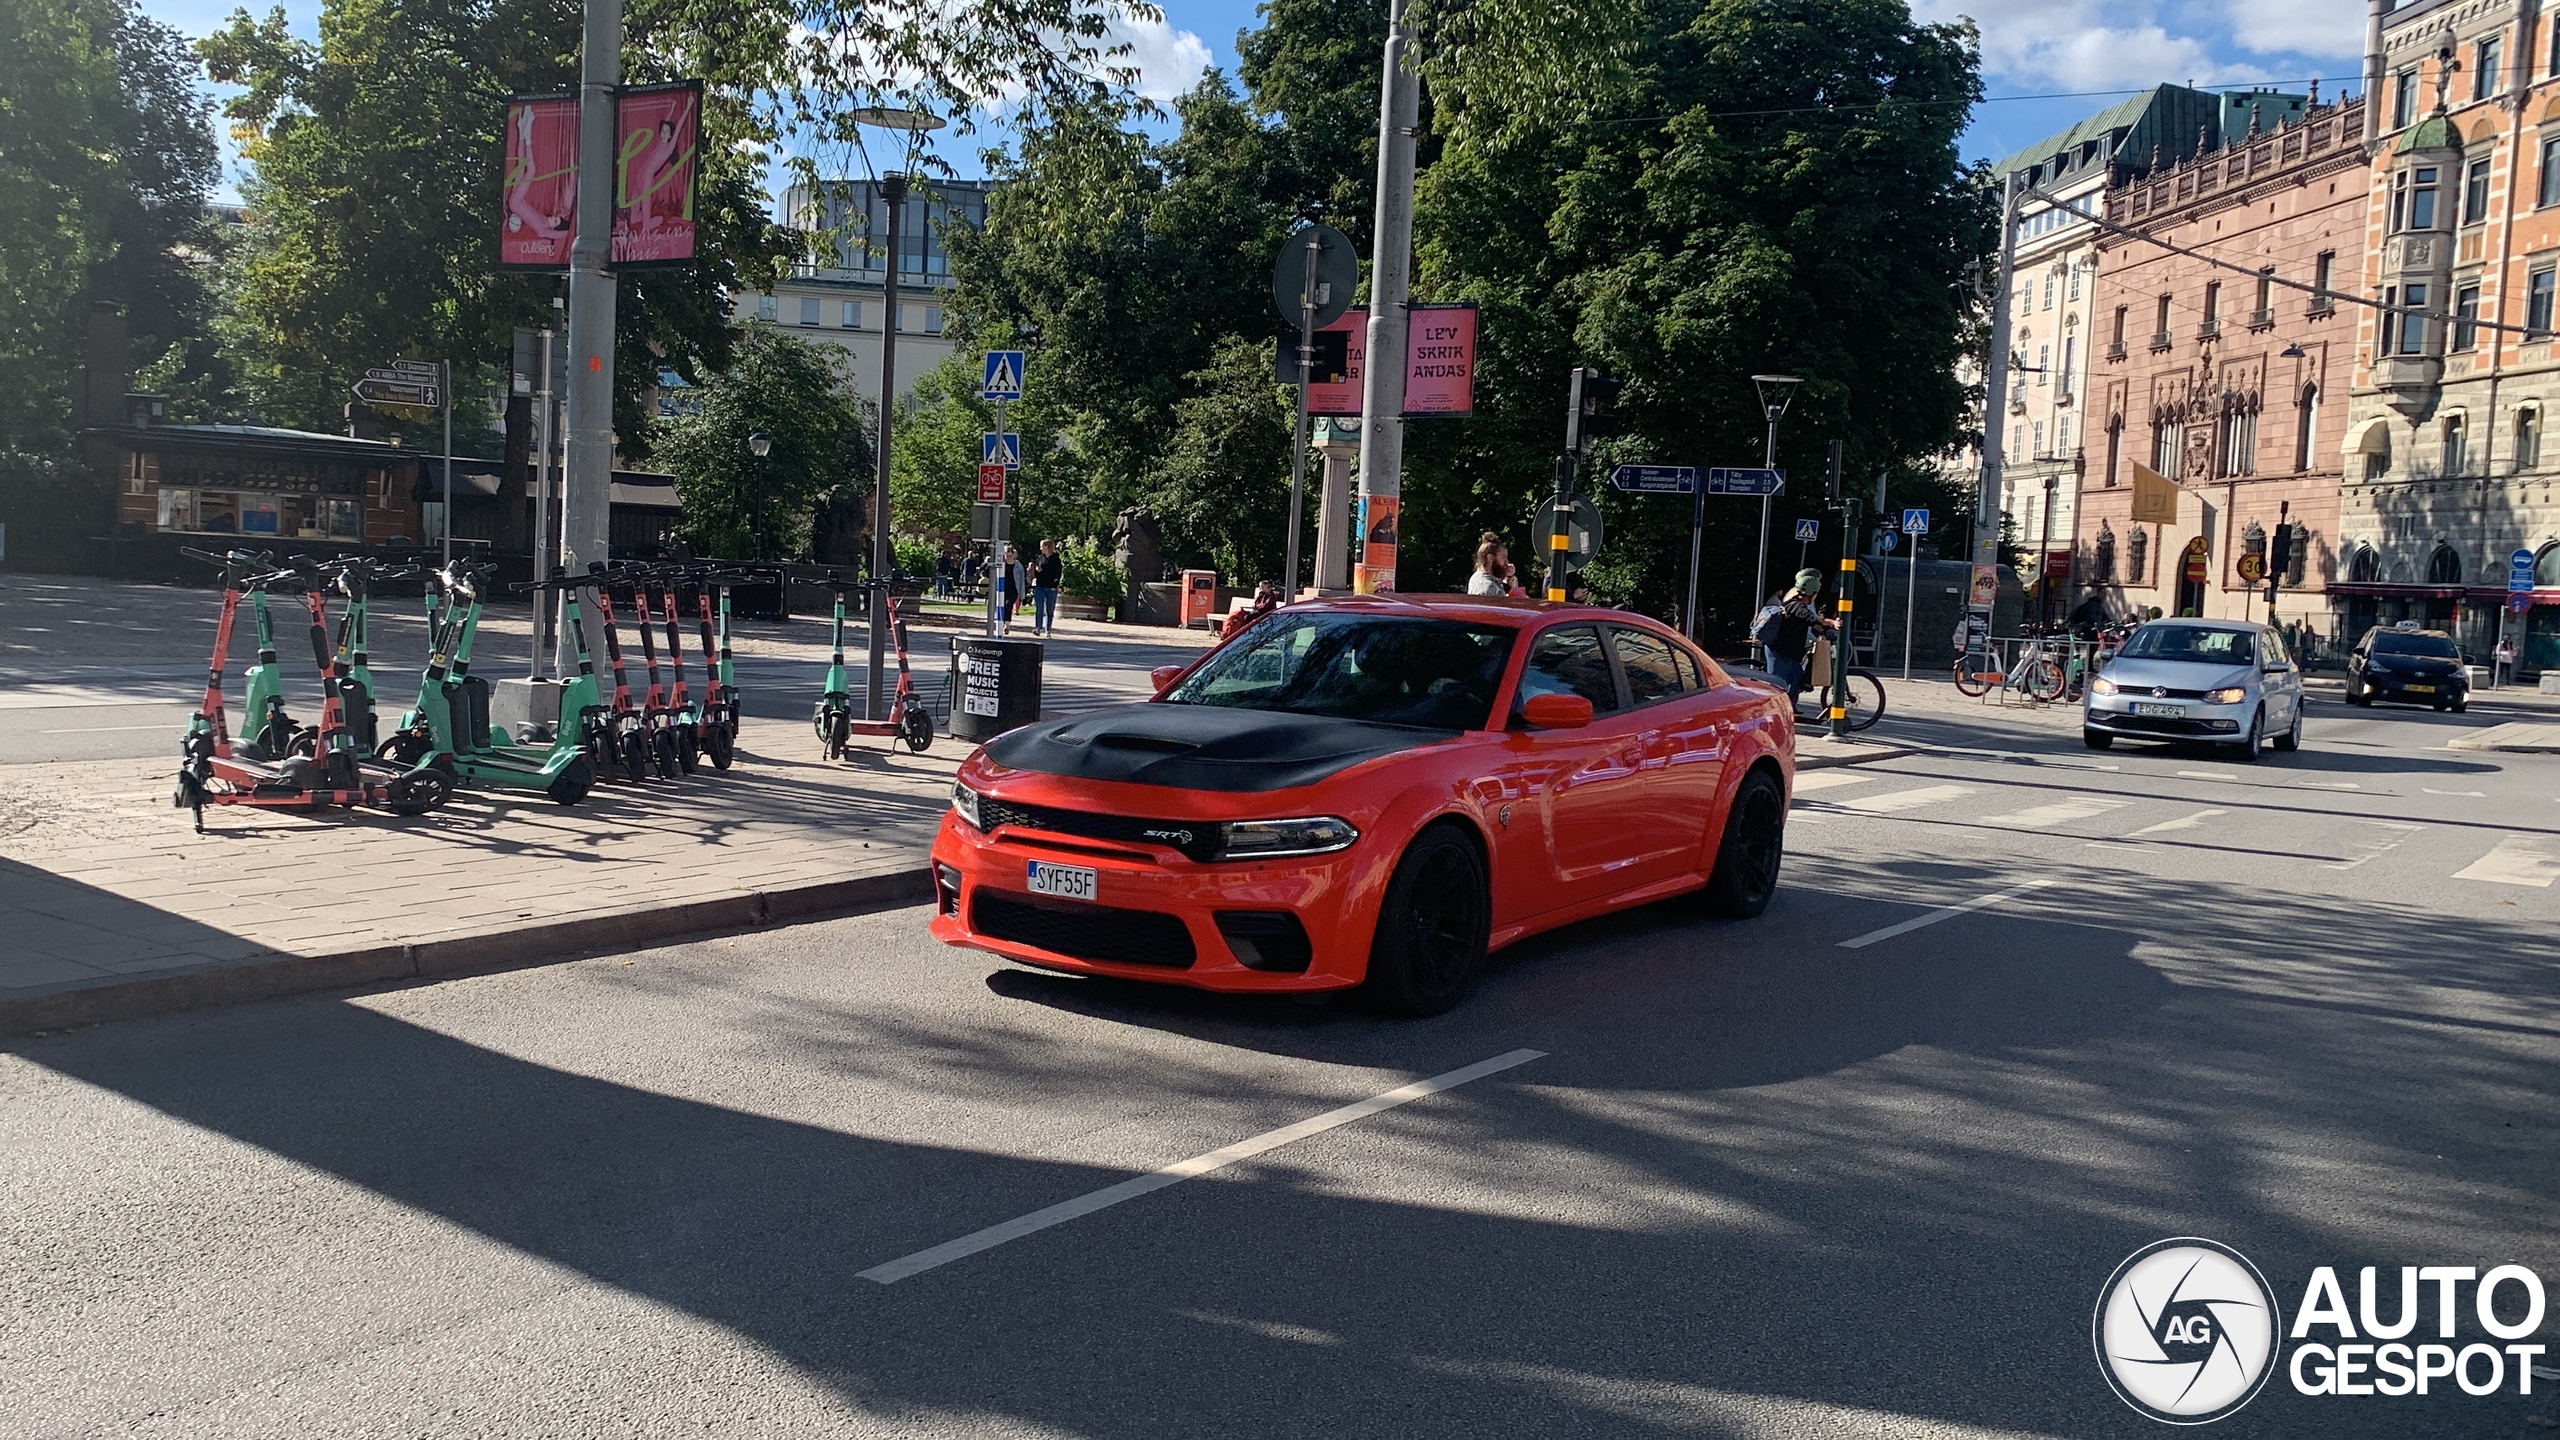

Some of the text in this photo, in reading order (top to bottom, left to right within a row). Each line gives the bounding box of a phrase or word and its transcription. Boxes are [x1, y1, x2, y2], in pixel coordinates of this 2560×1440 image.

[1425, 327, 1458, 340] LEV
[1417, 346, 1464, 359] SKRIK
[1413, 364, 1466, 378] ANDAS
[968, 660, 1001, 677] FREE
[967, 675, 1000, 688] MUSIC
[966, 687, 999, 697] PROJECTS
[561, 720, 573, 737] Bolt
[1143, 829, 1182, 840] SRT
[1037, 866, 1094, 896] SYF55F
